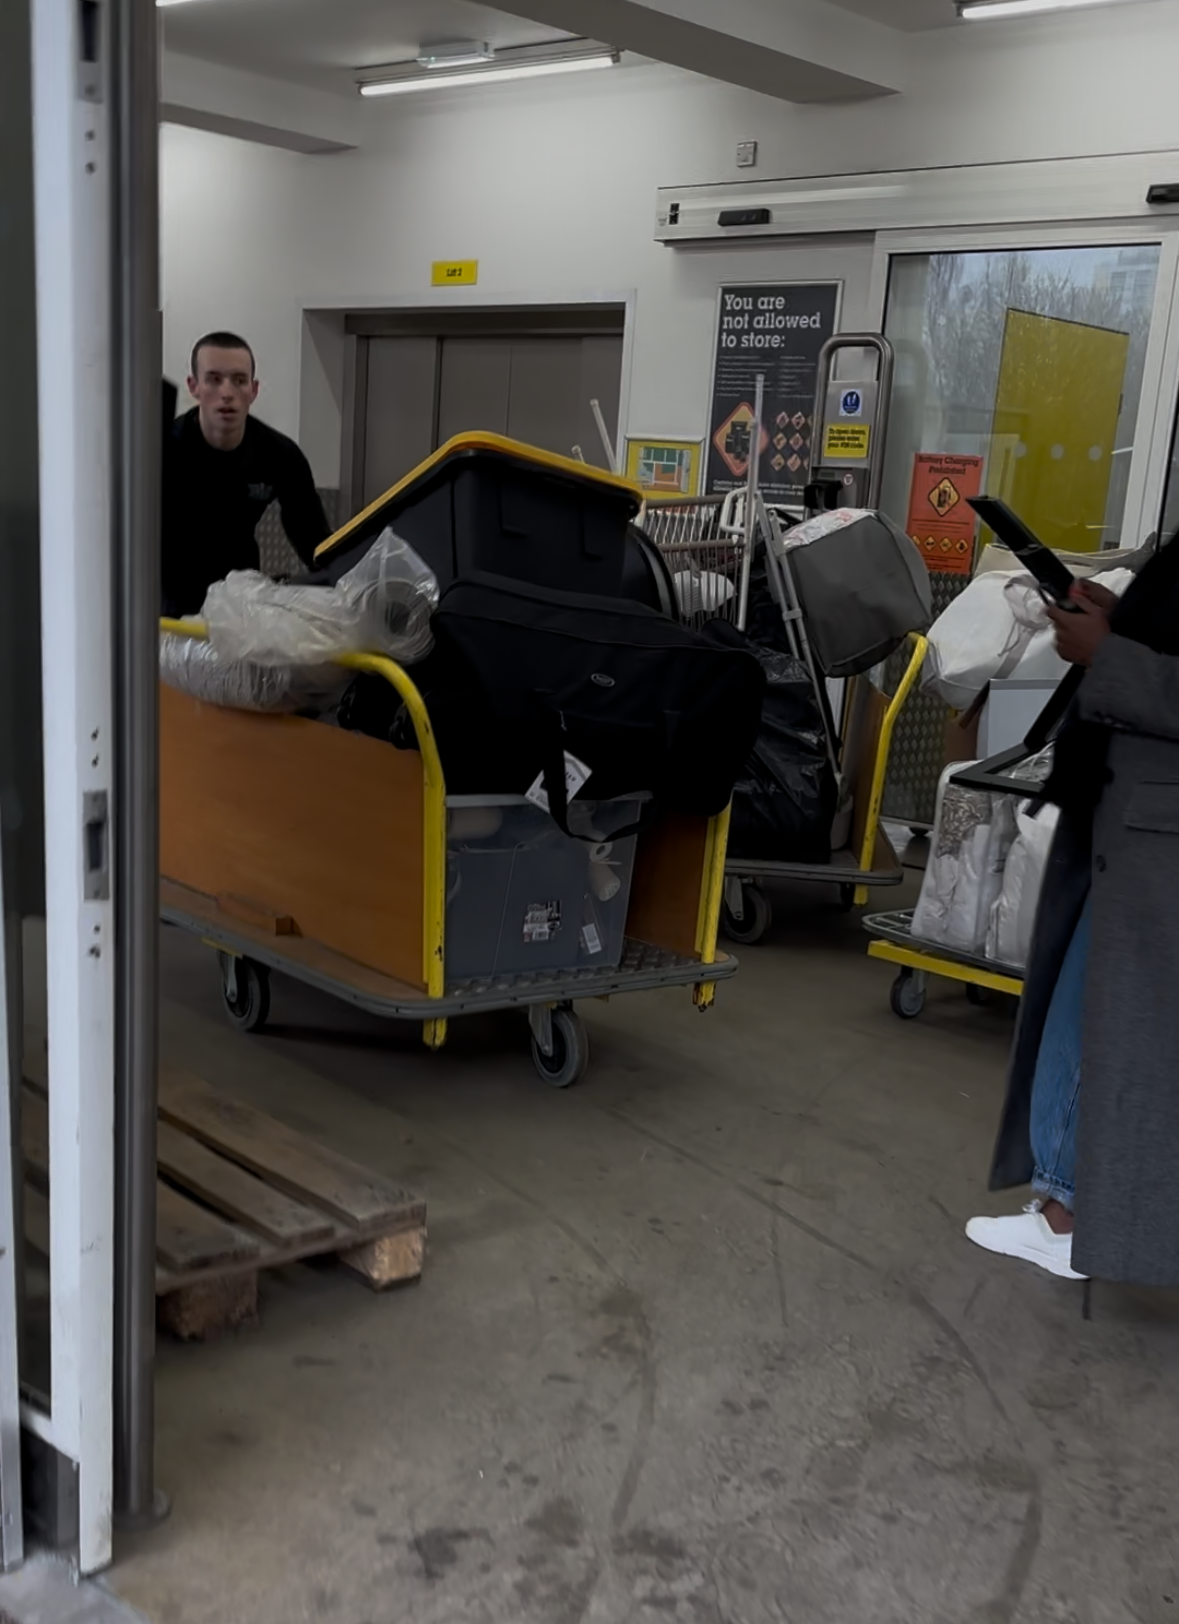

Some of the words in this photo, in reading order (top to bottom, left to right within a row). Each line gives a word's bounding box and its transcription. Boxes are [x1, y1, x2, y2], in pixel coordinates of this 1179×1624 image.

[724, 294, 753, 310] You
[757, 296, 785, 310] are
[722, 312, 749, 329] not
[753, 312, 821, 329] allowed
[721, 332, 737, 348] to
[741, 332, 785, 348] store:
